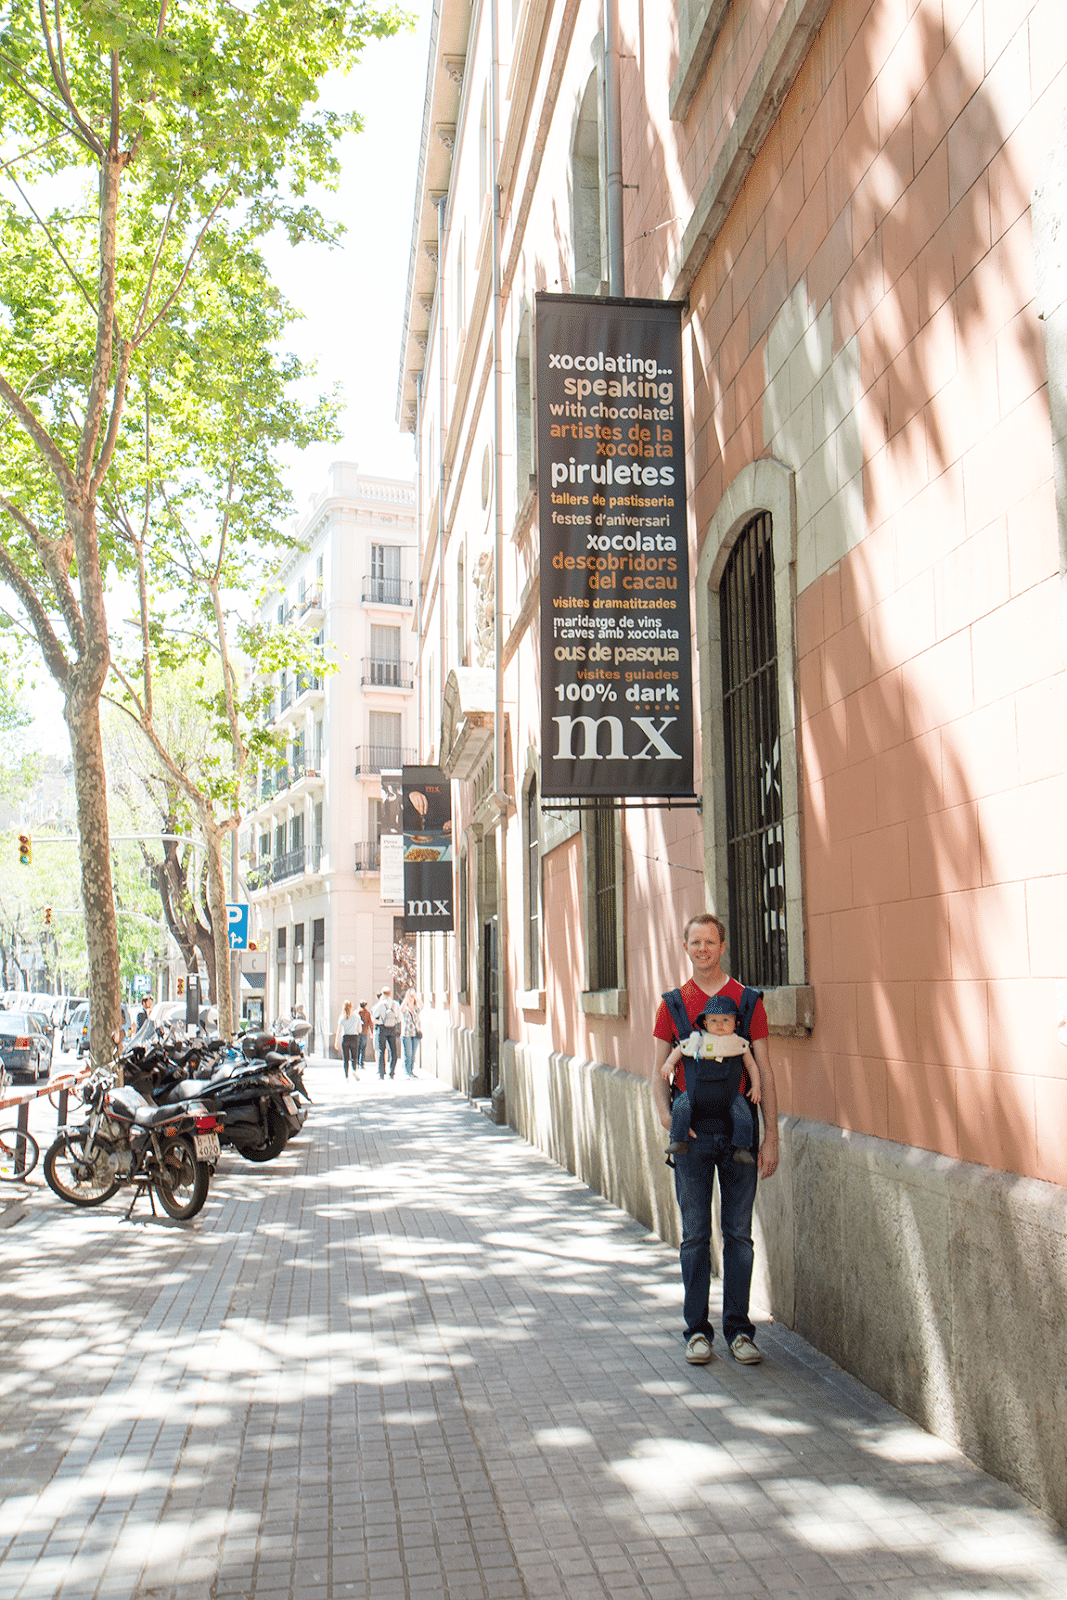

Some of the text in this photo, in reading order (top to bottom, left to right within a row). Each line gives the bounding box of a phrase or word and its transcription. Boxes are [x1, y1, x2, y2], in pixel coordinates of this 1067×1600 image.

[549, 352, 672, 379] xocolating...
[564, 375, 673, 405] speaking
[549, 401, 674, 420] with chocolate!
[550, 422, 673, 441] artistes de la
[596, 441, 673, 457] xocolata
[552, 457, 675, 488] piruletes
[551, 492, 674, 508] tallers de pastisseria
[552, 512, 591, 525] festes
[587, 532, 676, 551] xocolata
[552, 552, 677, 571] descobridors
[589, 572, 677, 590] del cacau
[553, 596, 676, 609] visites dramatitzades
[553, 615, 662, 630] maridatge de vins
[554, 626, 679, 639] i caves amb xocolata
[554, 643, 679, 665] ous de pasqua
[577, 669, 679, 681] visites guiades
[555, 683, 679, 702] 100% dark
[552, 716, 682, 759] mx
[225, 906, 243, 923] P
[407, 899, 451, 917] mx
[136, 977, 146, 991] P
